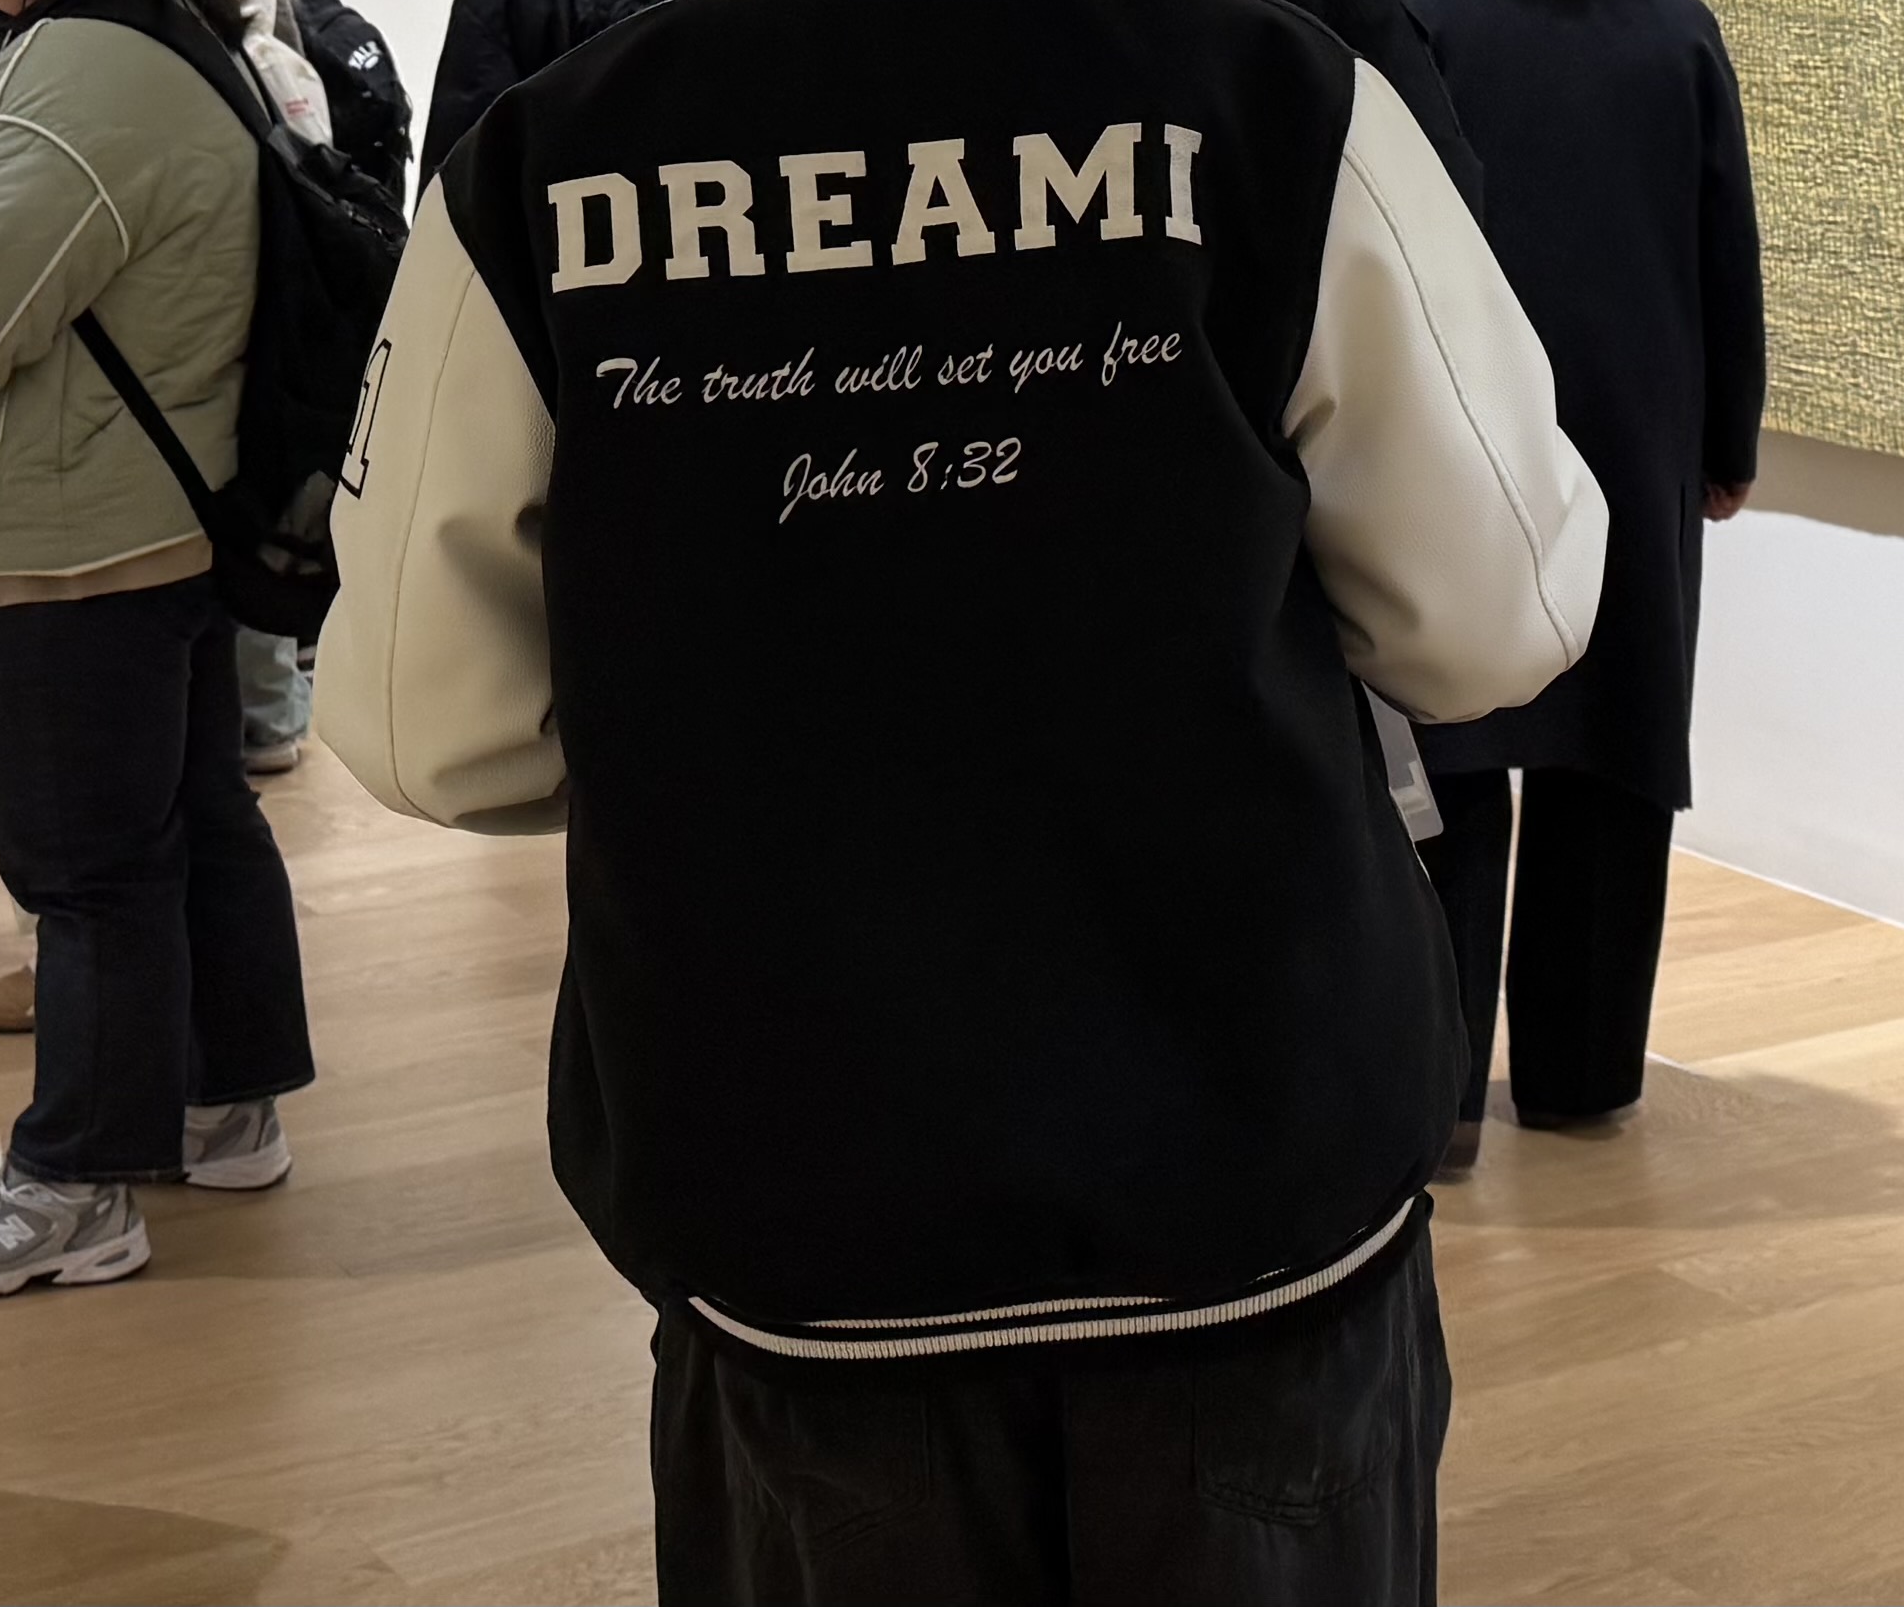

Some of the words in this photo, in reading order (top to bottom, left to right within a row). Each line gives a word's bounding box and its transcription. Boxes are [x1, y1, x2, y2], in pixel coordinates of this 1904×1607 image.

[547, 122, 1203, 293] DREAMI
[596, 357, 683, 409] The
[701, 347, 816, 404] truth
[834, 344, 923, 394] will
[937, 343, 994, 386] set
[1008, 342, 1084, 394] you
[1100, 321, 1183, 387] free
[778, 448, 885, 525] John
[907, 437, 1022, 493] 8:32
